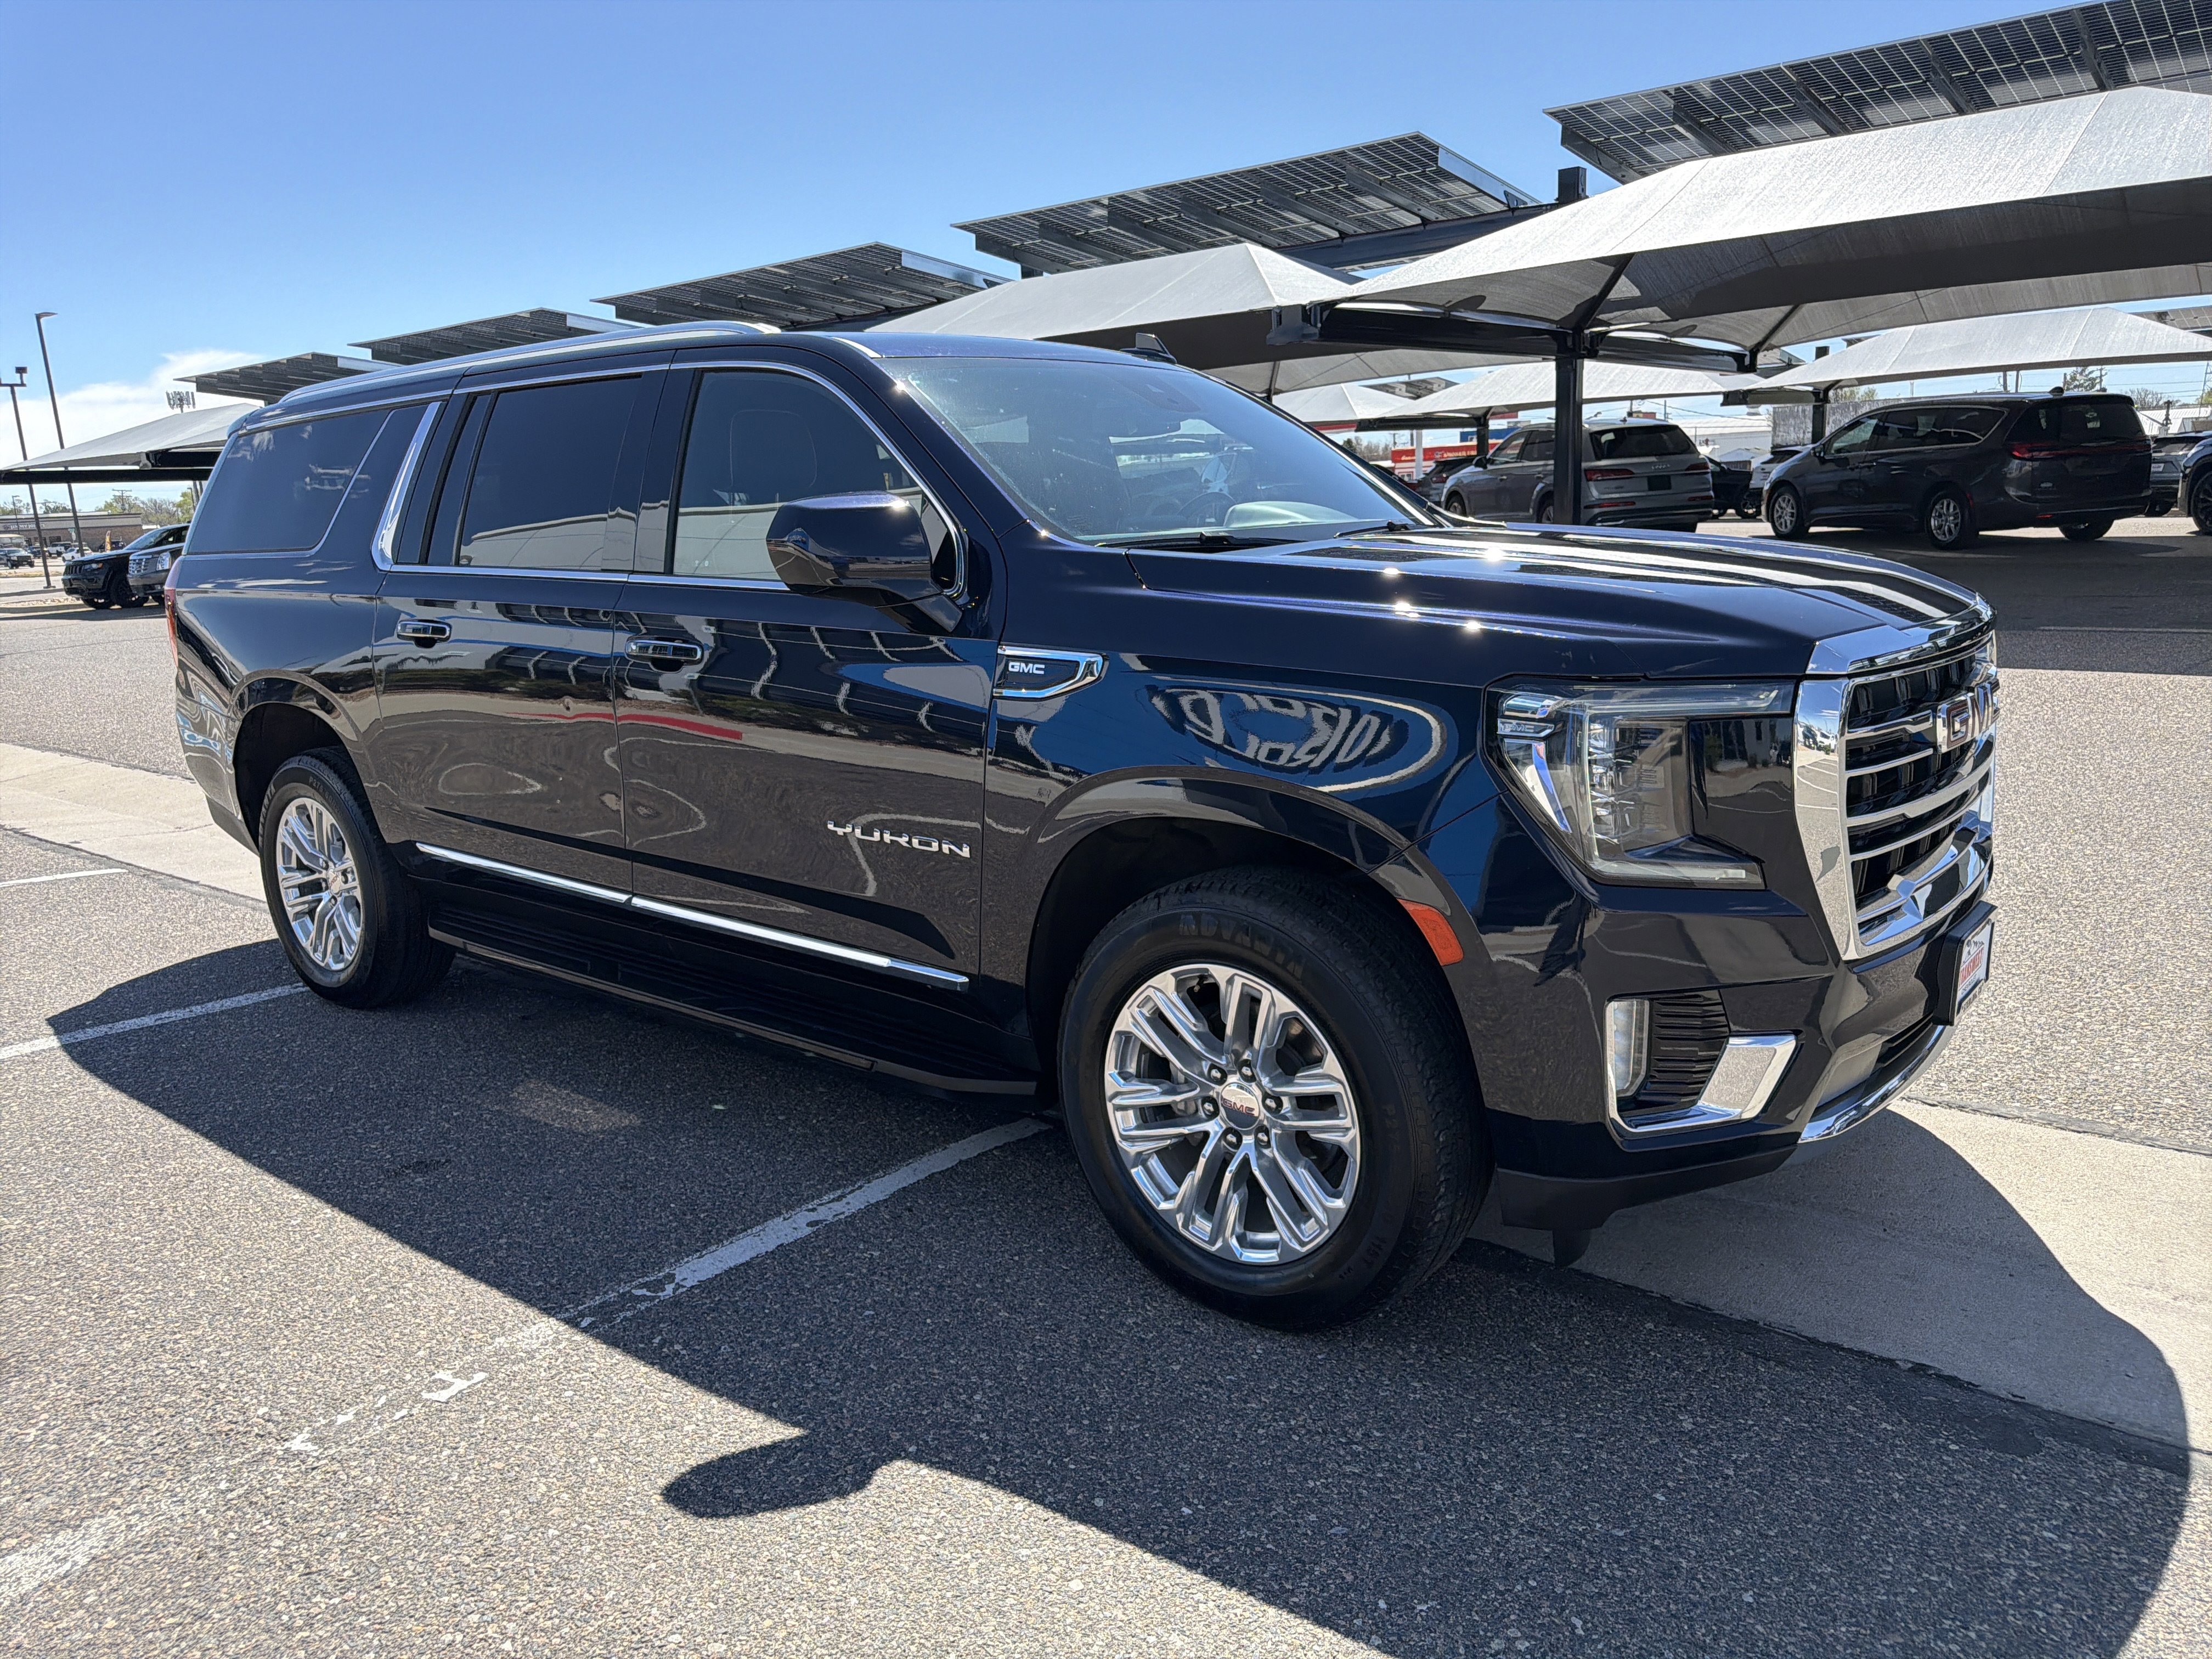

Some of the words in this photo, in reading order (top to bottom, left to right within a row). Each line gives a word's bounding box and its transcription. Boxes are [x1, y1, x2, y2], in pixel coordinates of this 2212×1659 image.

[1009, 662, 1045, 675] GMC
[1503, 723, 1534, 732] GMC
[827, 821, 970, 858] YUKON
[1180, 913, 1305, 979] ADVANTA
[1960, 947, 1984, 986] TRANSWEST
[1223, 1098, 1255, 1116] GMC
